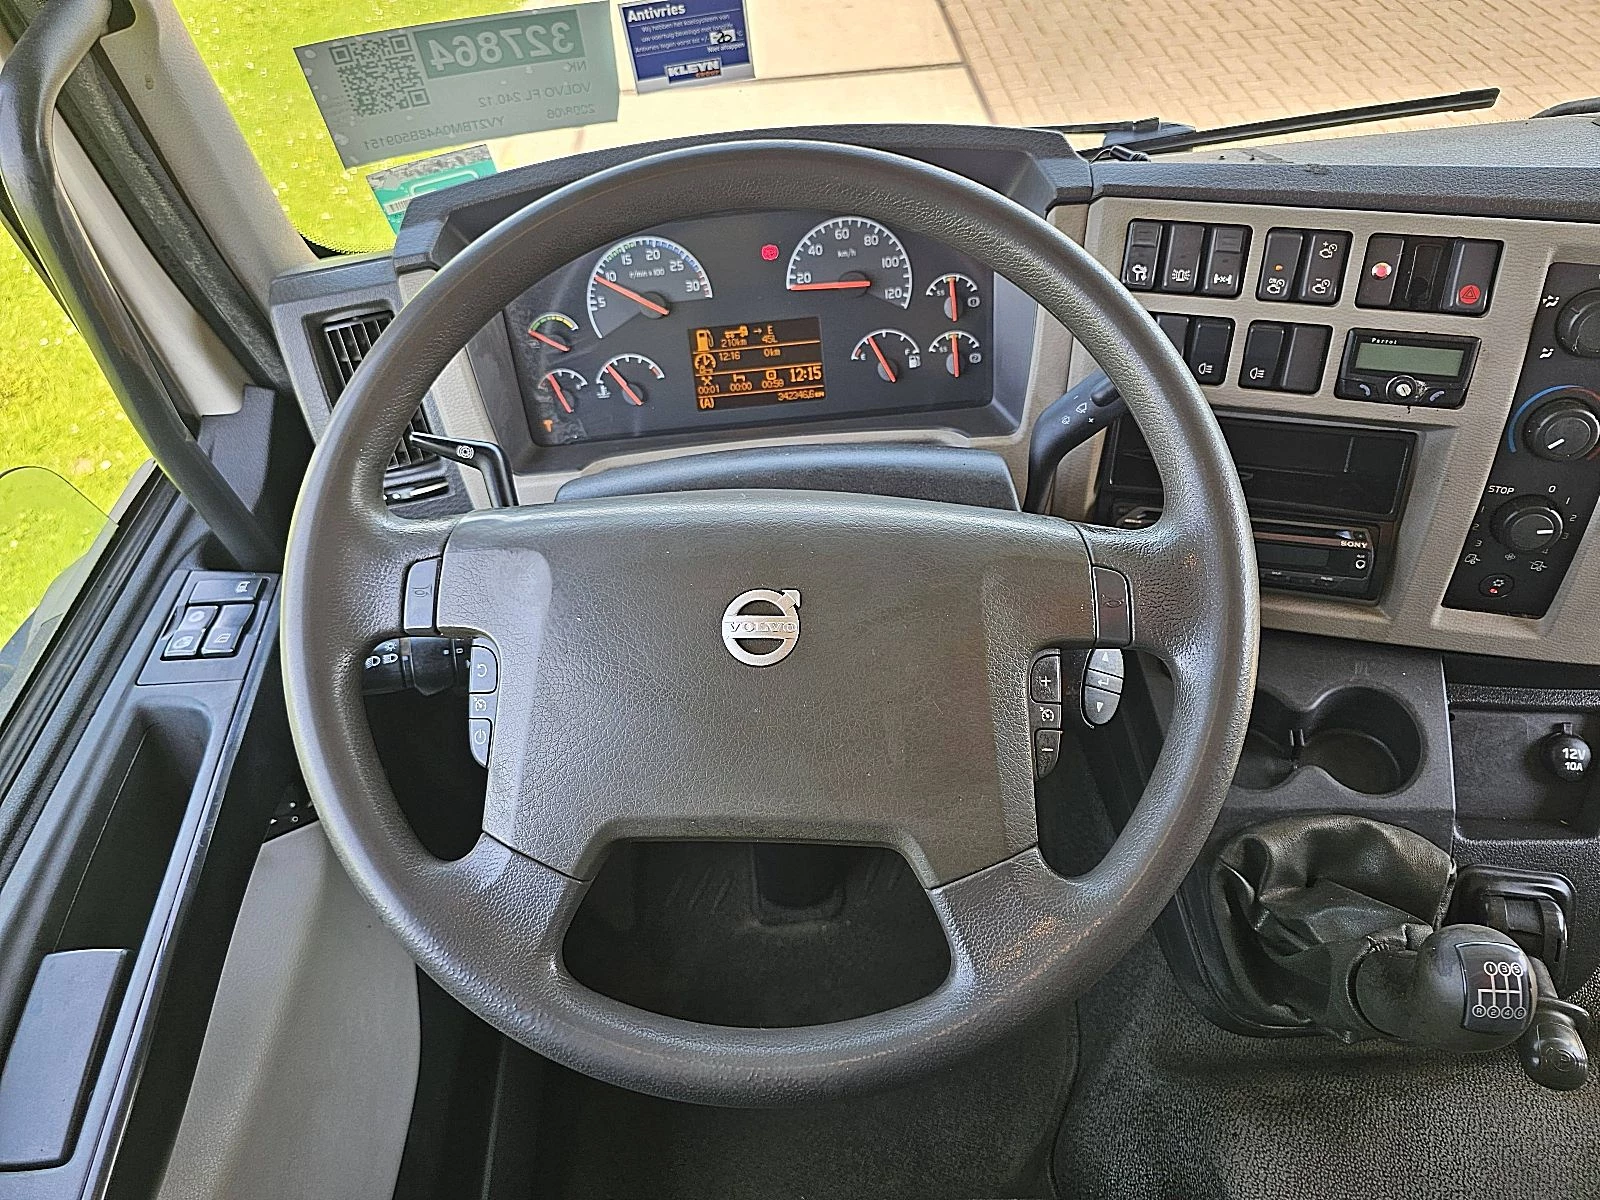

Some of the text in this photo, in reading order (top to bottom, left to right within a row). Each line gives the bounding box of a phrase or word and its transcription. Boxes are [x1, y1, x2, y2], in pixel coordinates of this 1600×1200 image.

[628, 4, 686, 23] Antivries
[668, 60, 720, 77] KLEYN
[834, 228, 850, 240] 60
[863, 235, 879, 246] 80
[645, 249, 661, 260] 20
[808, 244, 823, 256] 40
[837, 248, 857, 258] km/h
[621, 253, 632, 266] 15
[881, 257, 899, 268] 100
[669, 260, 684, 272] 25
[605, 271, 617, 282] 10
[796, 272, 812, 283] 20
[685, 280, 700, 292] 30
[884, 288, 902, 299] 120
[598, 297, 606, 308] 5
[767, 325, 773, 335] E
[1371, 337, 1397, 345] Parrot
[719, 351, 741, 361] 12:16
[698, 384, 720, 394] 00:01
[730, 382, 752, 391] 00:00
[790, 366, 822, 382] 12:15
[1488, 485, 1515, 495] STOP
[1548, 485, 1557, 493] 0
[1565, 497, 1571, 505] 1
[1569, 514, 1577, 522] 2
[1562, 532, 1570, 540] 3
[1340, 540, 1368, 549] SONY
[730, 621, 798, 634] VOLVO
[1562, 747, 1586, 761] 12V
[1564, 761, 1583, 772] 10A
